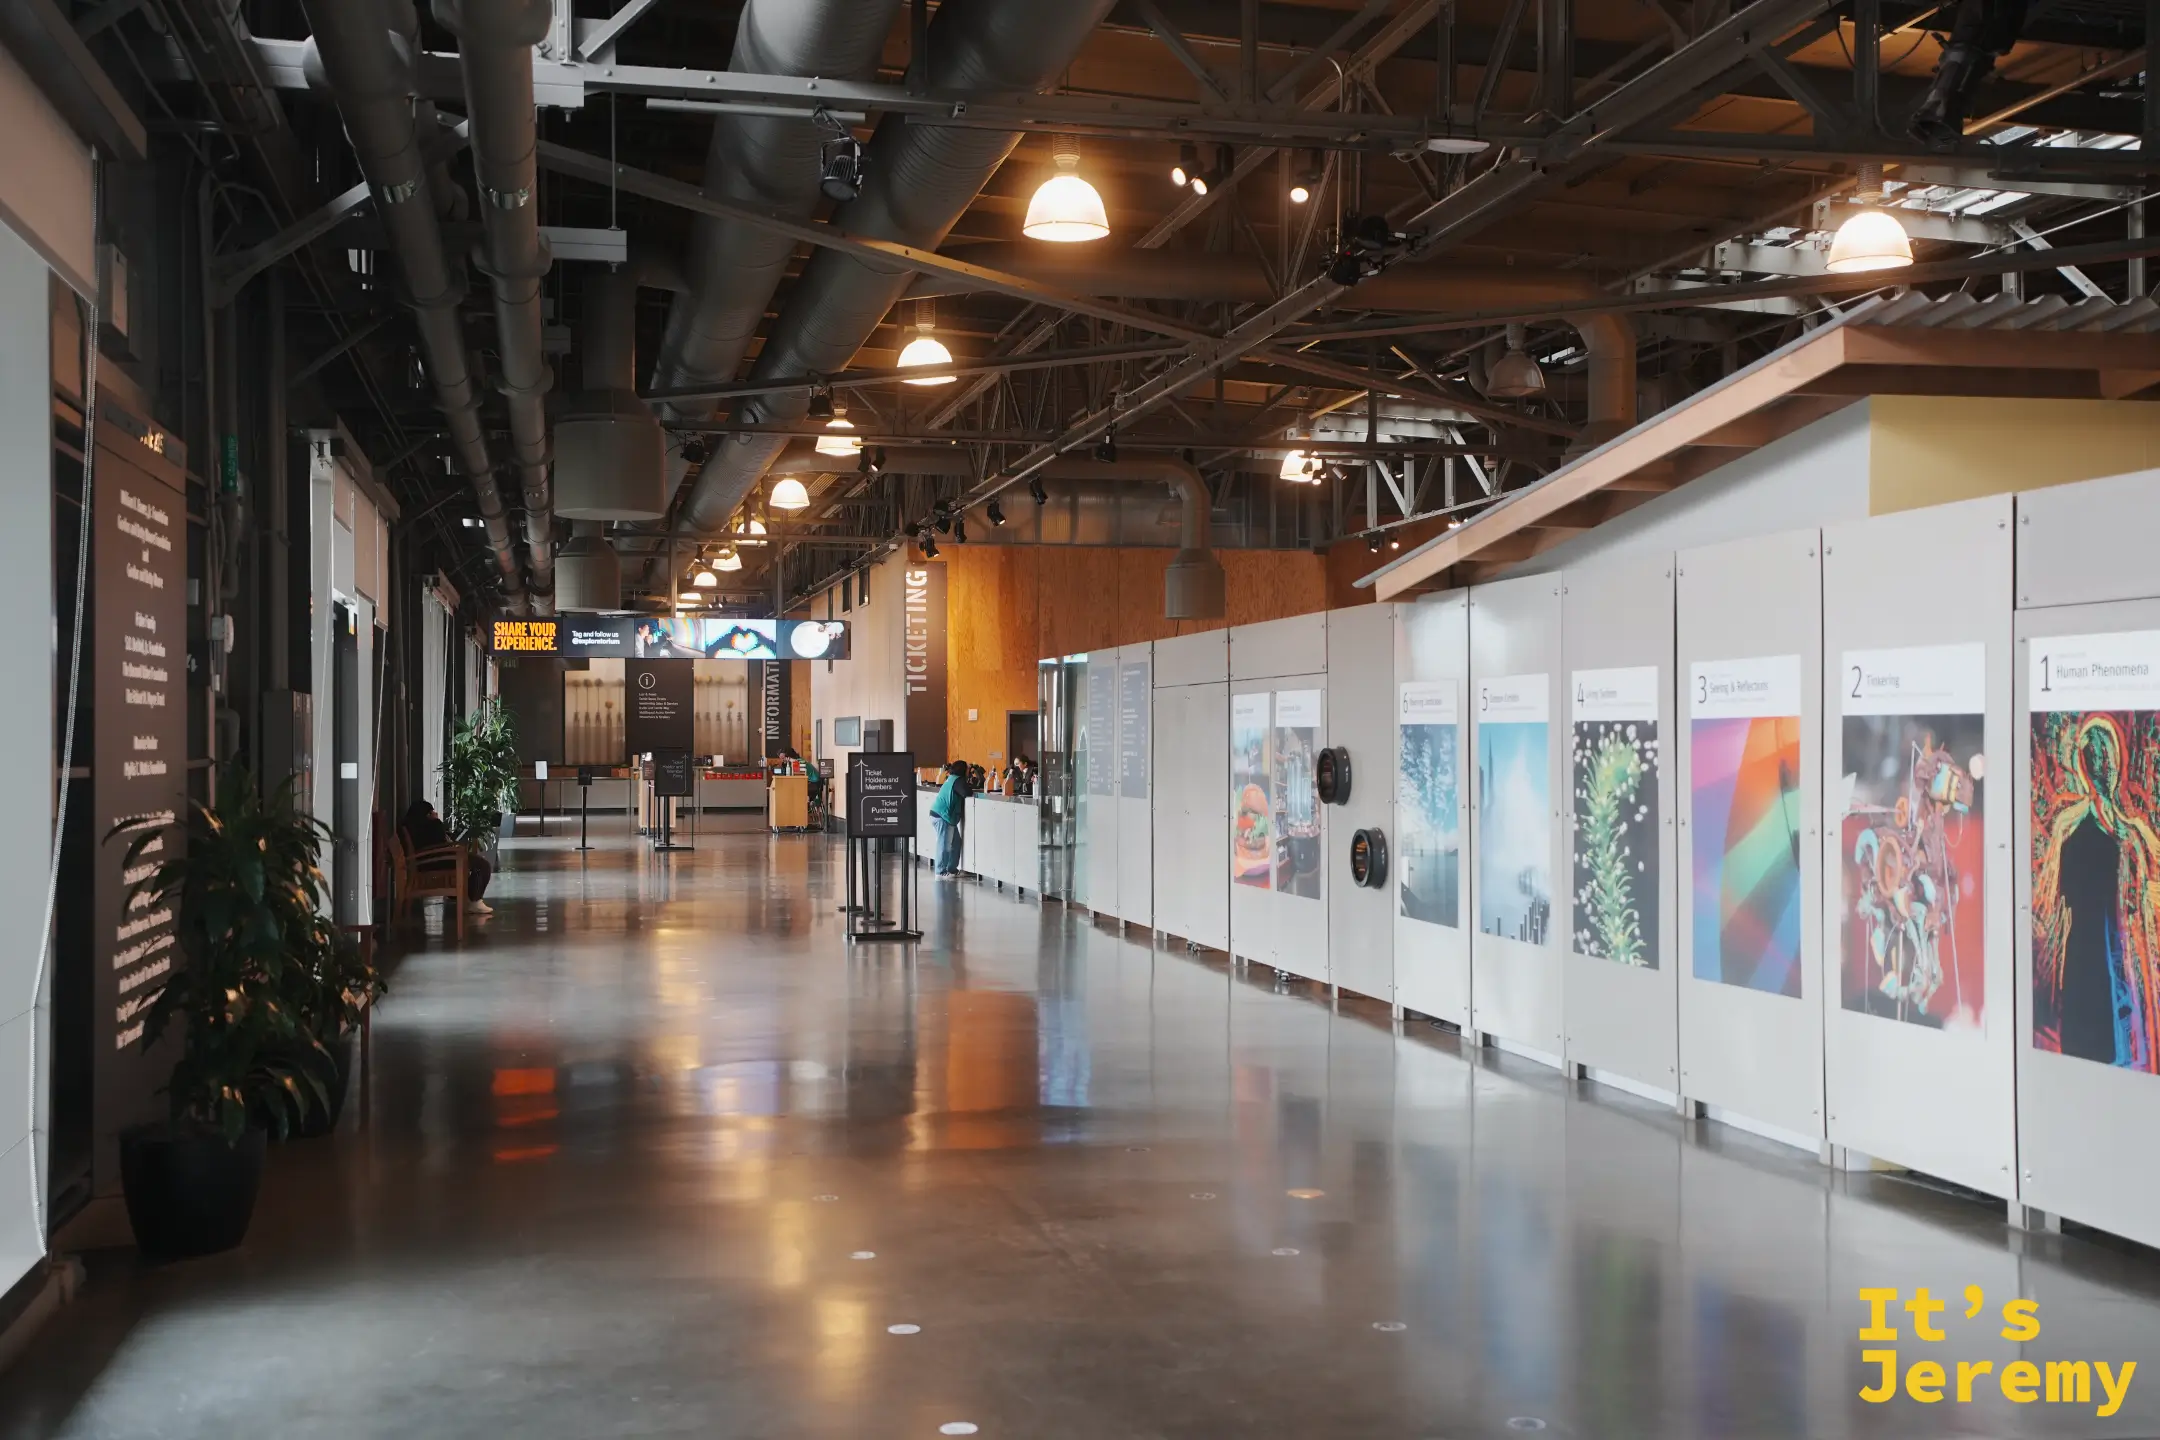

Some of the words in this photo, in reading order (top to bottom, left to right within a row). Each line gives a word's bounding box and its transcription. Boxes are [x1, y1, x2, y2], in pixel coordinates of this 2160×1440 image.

[494, 621, 527, 637] SHARE
[528, 621, 556, 637] YOUR
[572, 630, 582, 638] Tag
[583, 630, 594, 638] and
[594, 630, 611, 638] follow
[905, 570, 928, 696] TICKETING
[494, 636, 558, 651] EXPERIENCE.
[1851, 665, 1862, 699] 2
[1866, 673, 1900, 688] Tinkering
[2040, 655, 2052, 692] 1
[2056, 665, 2088, 679] Human
[2091, 663, 2149, 677] Phenomena
[766, 661, 780, 740] INFORMATI
[1482, 687, 1488, 712] 5
[1577, 682, 1585, 708] 4
[1698, 675, 1707, 704] 3
[1403, 692, 1409, 714] 6
